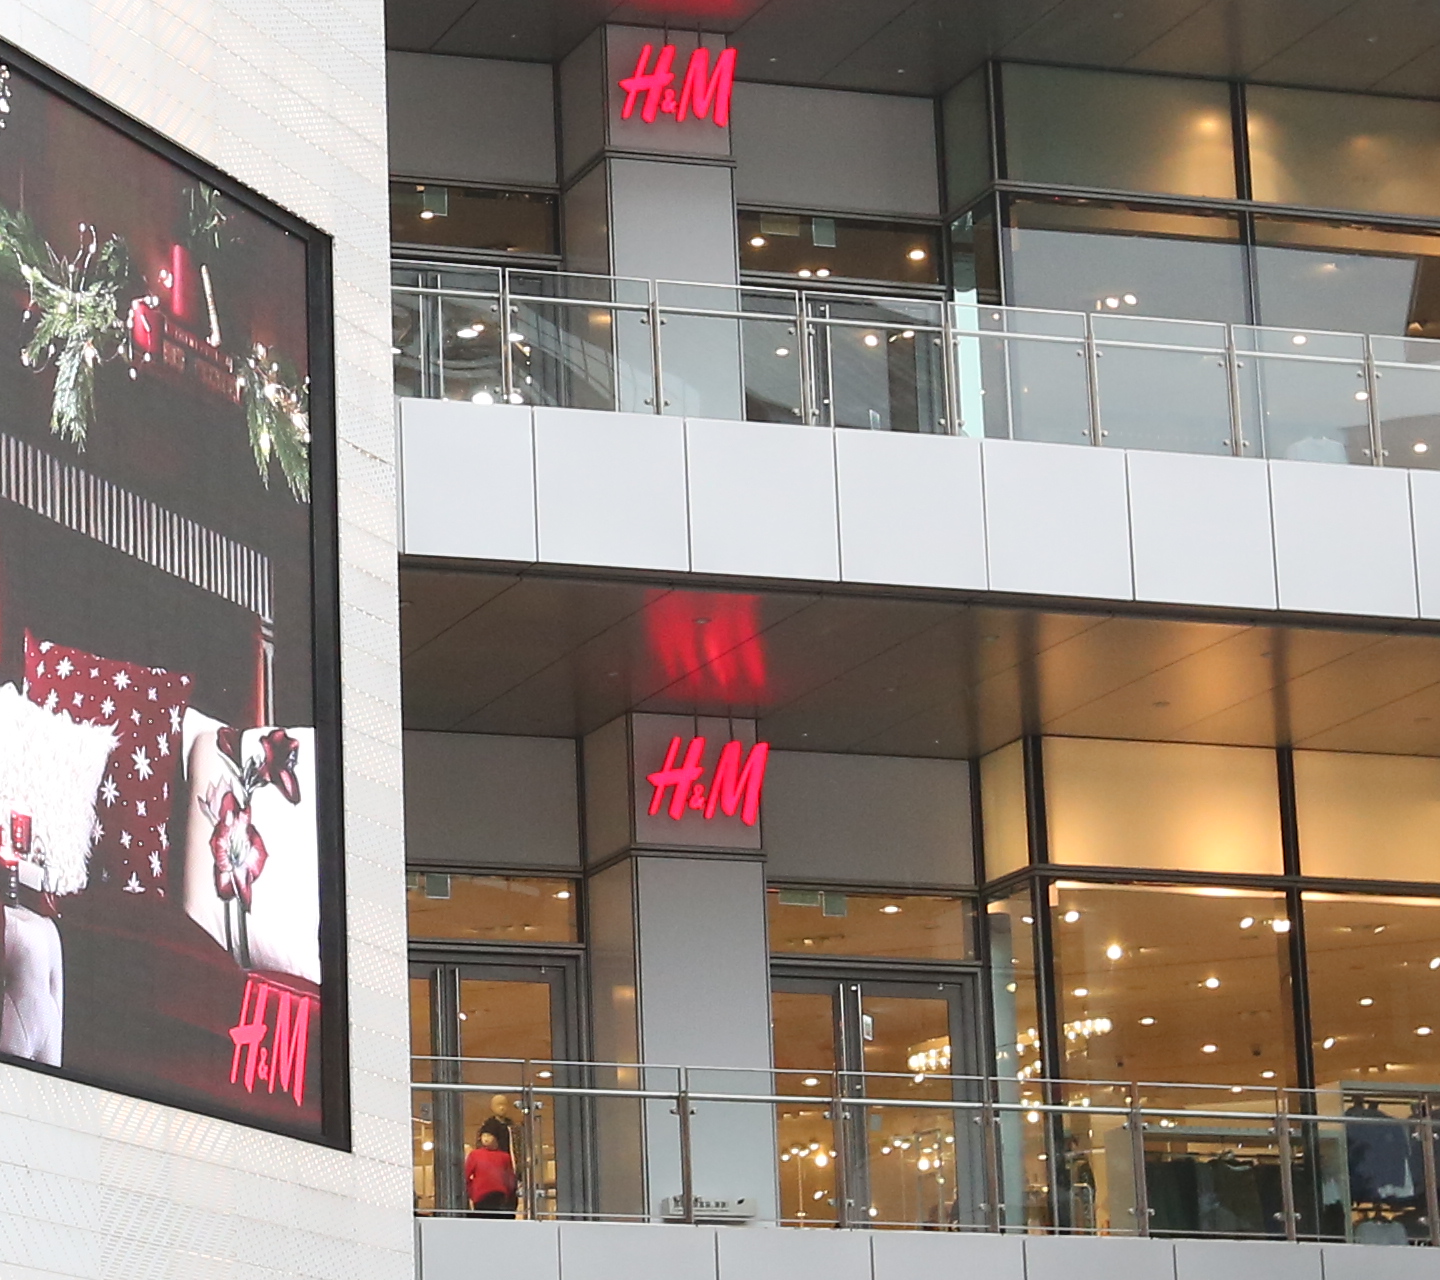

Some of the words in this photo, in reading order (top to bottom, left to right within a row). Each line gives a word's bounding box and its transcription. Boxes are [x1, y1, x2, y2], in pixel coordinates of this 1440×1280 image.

[619, 44, 737, 128] H&M
[646, 735, 769, 826] H&M
[229, 980, 311, 1107] H&M
